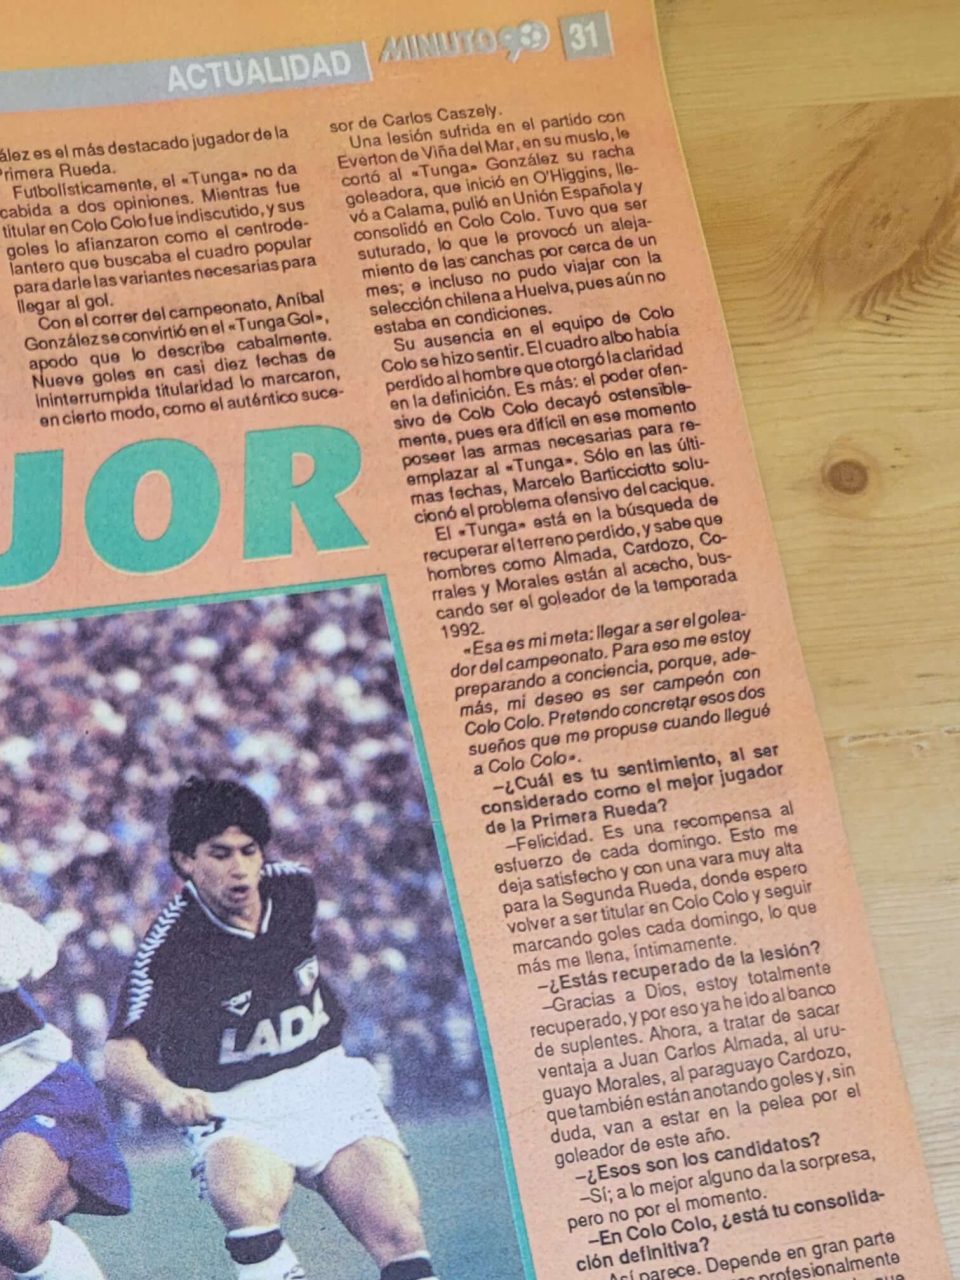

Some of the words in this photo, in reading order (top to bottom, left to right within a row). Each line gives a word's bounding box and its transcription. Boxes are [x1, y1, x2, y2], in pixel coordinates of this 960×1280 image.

[379, 28, 497, 63] MINUTO
[569, 22, 598, 50] 31
[167, 51, 351, 92] ACTUALIDAD
[329, 120, 354, 133] sor
[358, 115, 378, 131] de
[382, 111, 433, 128] Carlos
[437, 104, 502, 123] Caszely.
[60, 162, 116, 178] Rueda.
[10, 257, 64, 276] lantero
[69, 256, 99, 274] que
[104, 250, 171, 268] buscaba
[176, 247, 190, 262] el
[195, 243, 249, 260] cuadro
[254, 236, 311, 256] popular
[374, 317, 427, 335] estaba
[432, 316, 450, 327] en
[455, 305, 552, 326] condiciones.
[29, 354, 78, 374] apodo
[90, 352, 121, 368] que
[132, 346, 146, 361] lo
[158, 341, 225, 359] describe
[237, 331, 332, 352] cabalmente.
[428, 562, 496, 581] hombres
[503, 557, 546, 572] como
[553, 545, 617, 567] Almada,
[623, 537, 694, 557] Cardozo,
[699, 532, 727, 546] Co-
[486, 819, 506, 834] de
[511, 816, 526, 831] la
[532, 809, 597, 829] Primera
[603, 798, 667, 819] Rueda?
[554, 1142, 625, 1169] goleador
[630, 1138, 650, 1153] de
[656, 1133, 690, 1150] este
[695, 1128, 730, 1144] año.
